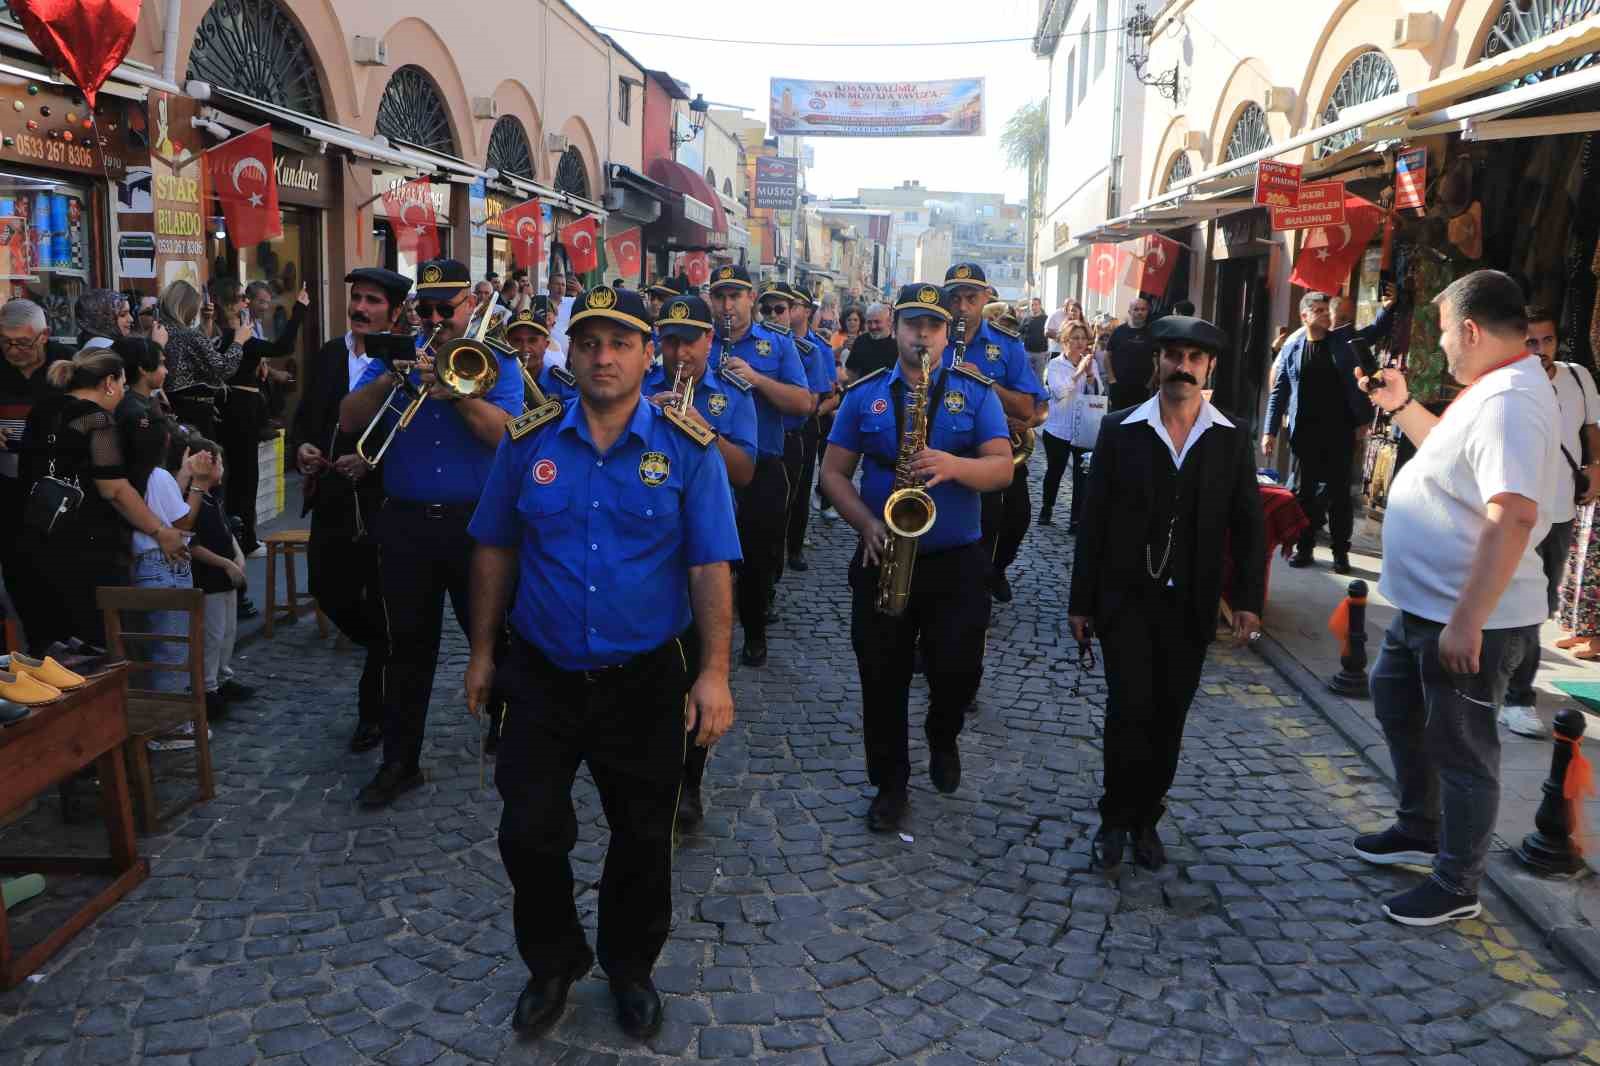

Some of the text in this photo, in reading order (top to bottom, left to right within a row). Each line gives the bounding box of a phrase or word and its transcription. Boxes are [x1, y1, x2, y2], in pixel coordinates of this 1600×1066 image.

[16, 133, 92, 169] 0533 267 8306
[157, 175, 199, 203] STAR
[273, 155, 320, 192] Kundura
